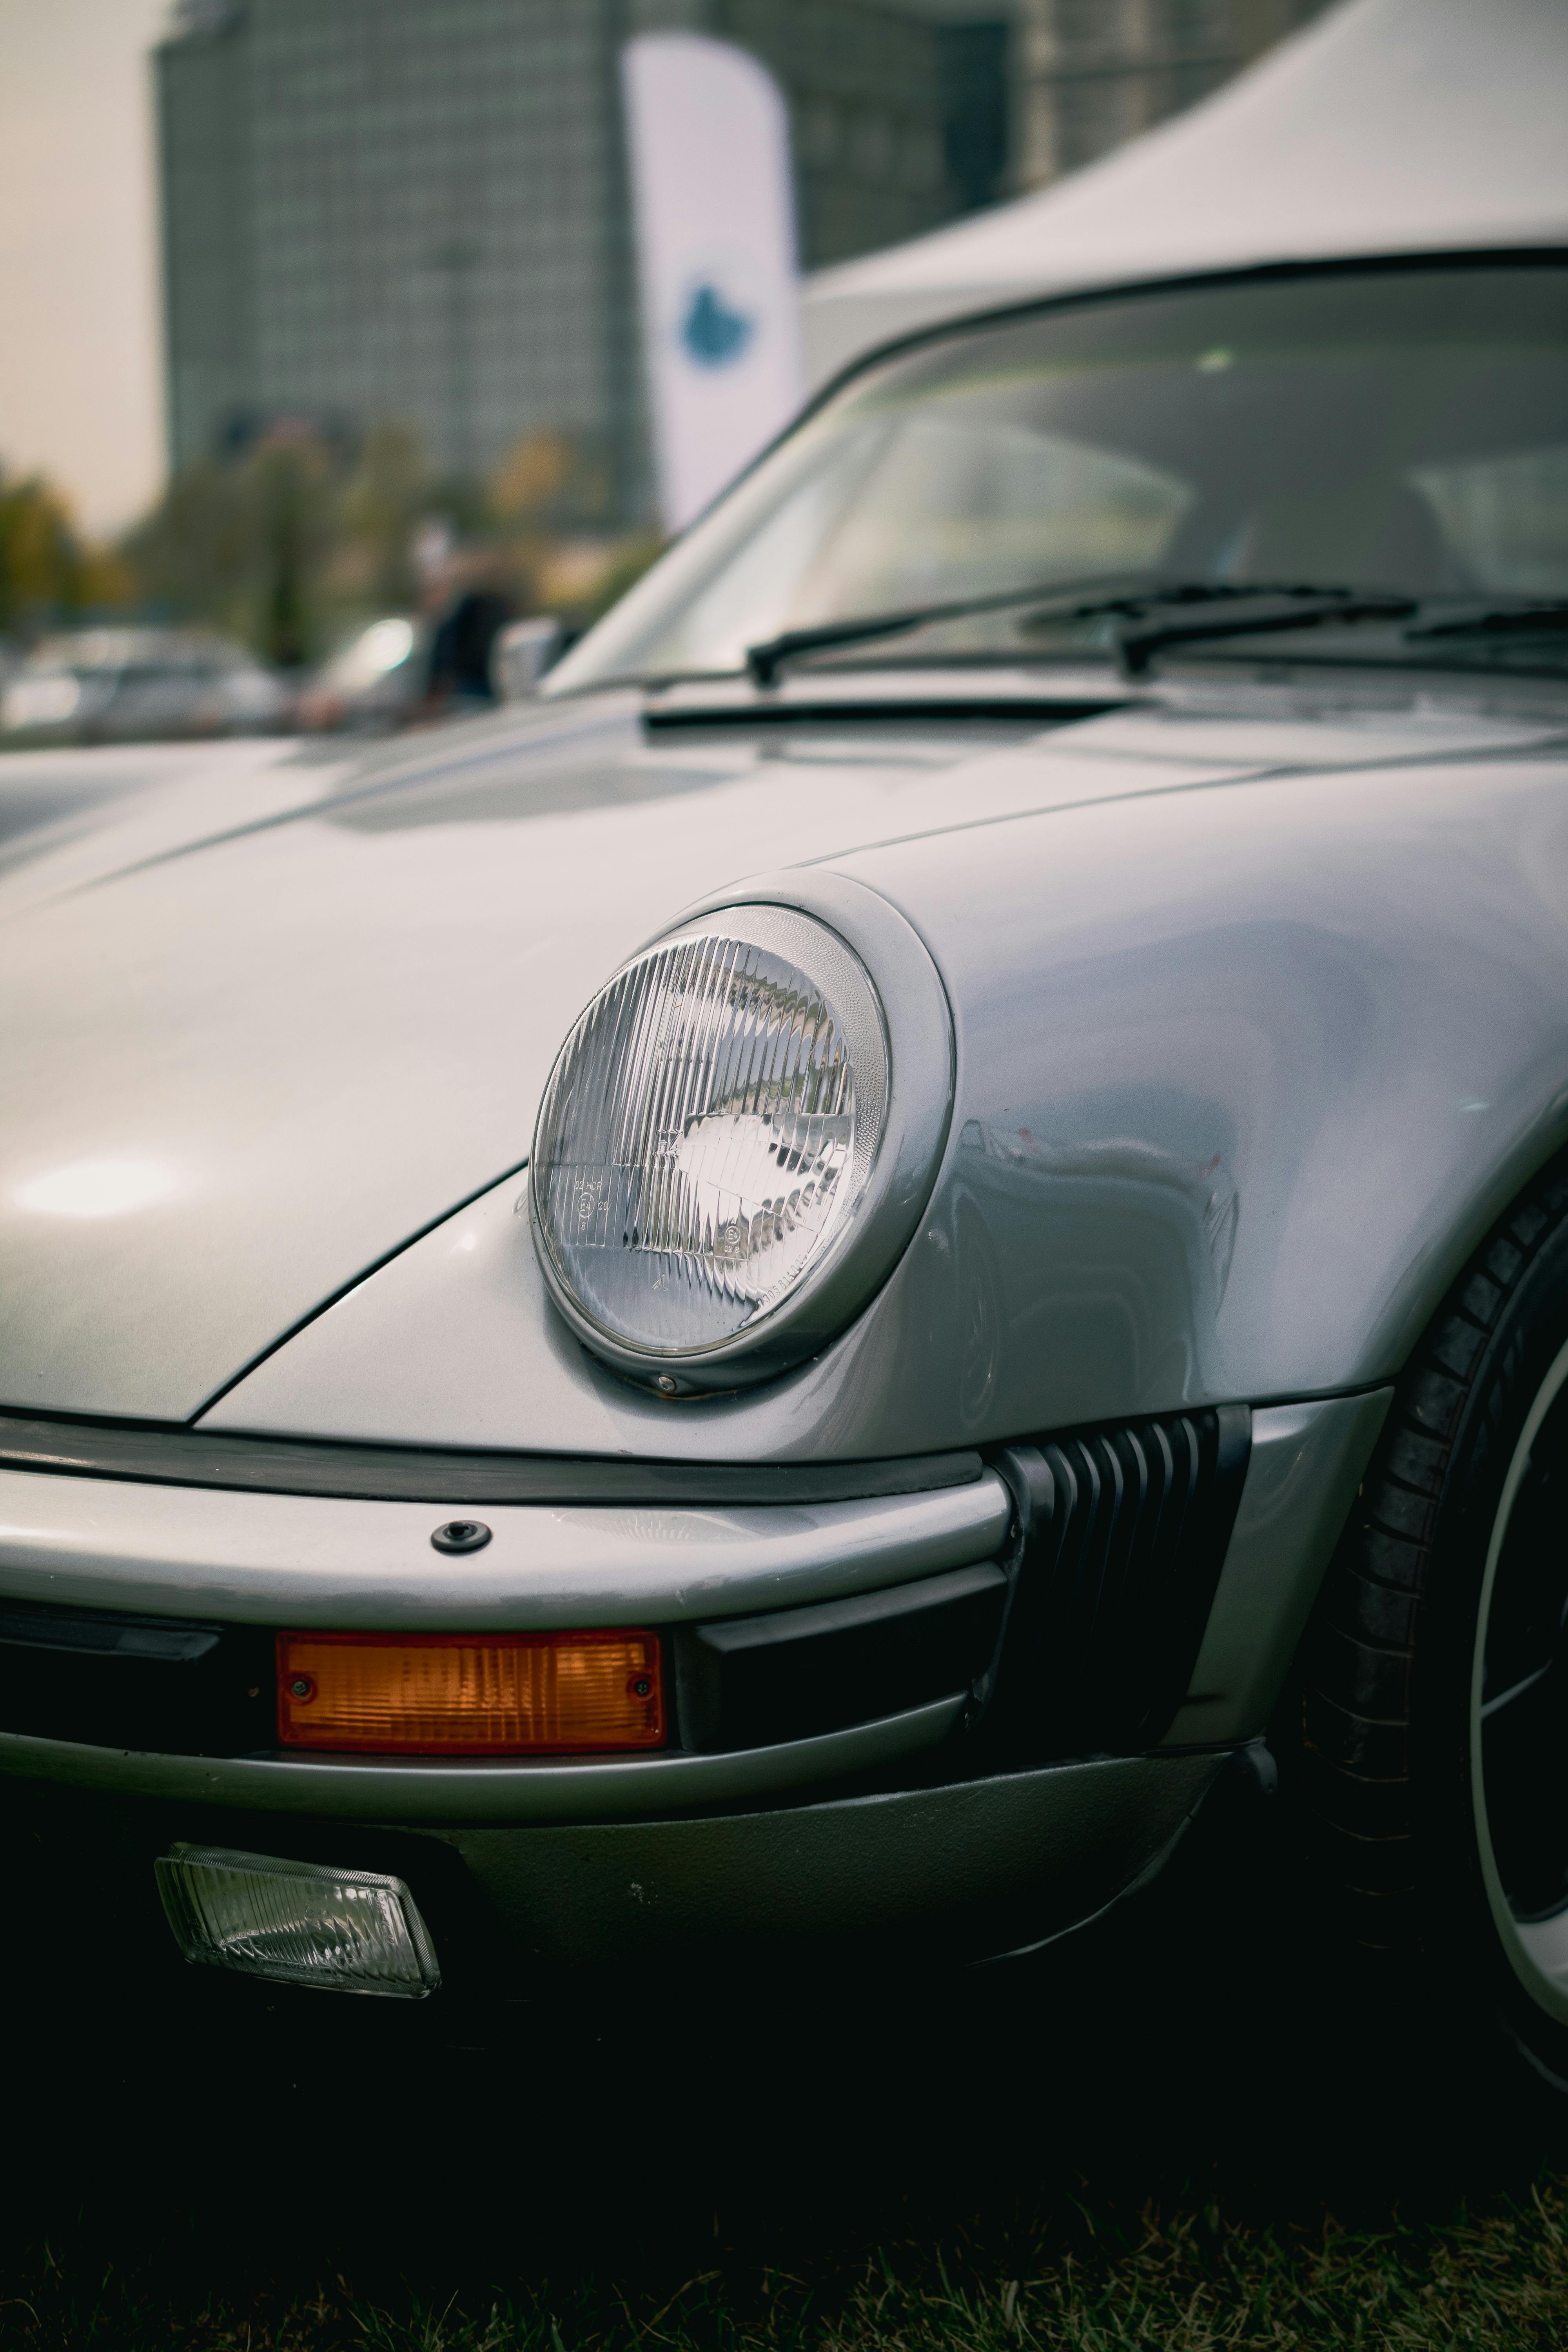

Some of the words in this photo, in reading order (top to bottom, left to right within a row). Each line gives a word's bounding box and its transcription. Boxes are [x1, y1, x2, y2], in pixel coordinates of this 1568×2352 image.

[575, 1180, 583, 1190] 02
[586, 1181, 602, 1190] HCR
[580, 1198, 590, 1212] E4
[598, 1201, 609, 1210] 20
